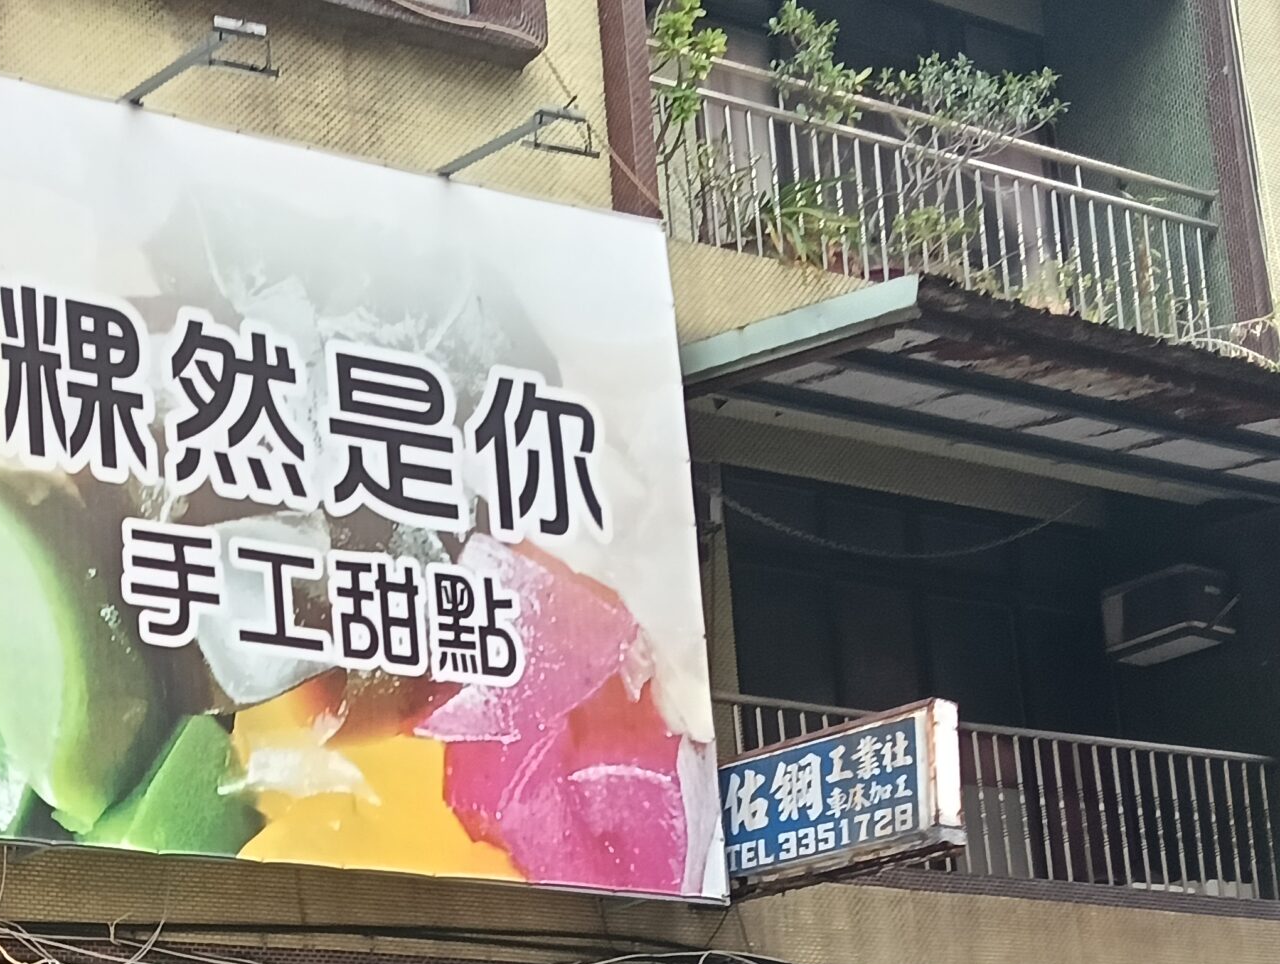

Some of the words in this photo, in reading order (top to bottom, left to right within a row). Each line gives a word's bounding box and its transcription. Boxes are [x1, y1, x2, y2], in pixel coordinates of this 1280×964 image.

[0, 285, 604, 533] 粿然是你
[129, 528, 518, 678] 手工甜點
[825, 731, 913, 784] 工業社
[726, 838, 775, 871] TEL
[777, 802, 914, 861] 3351728
